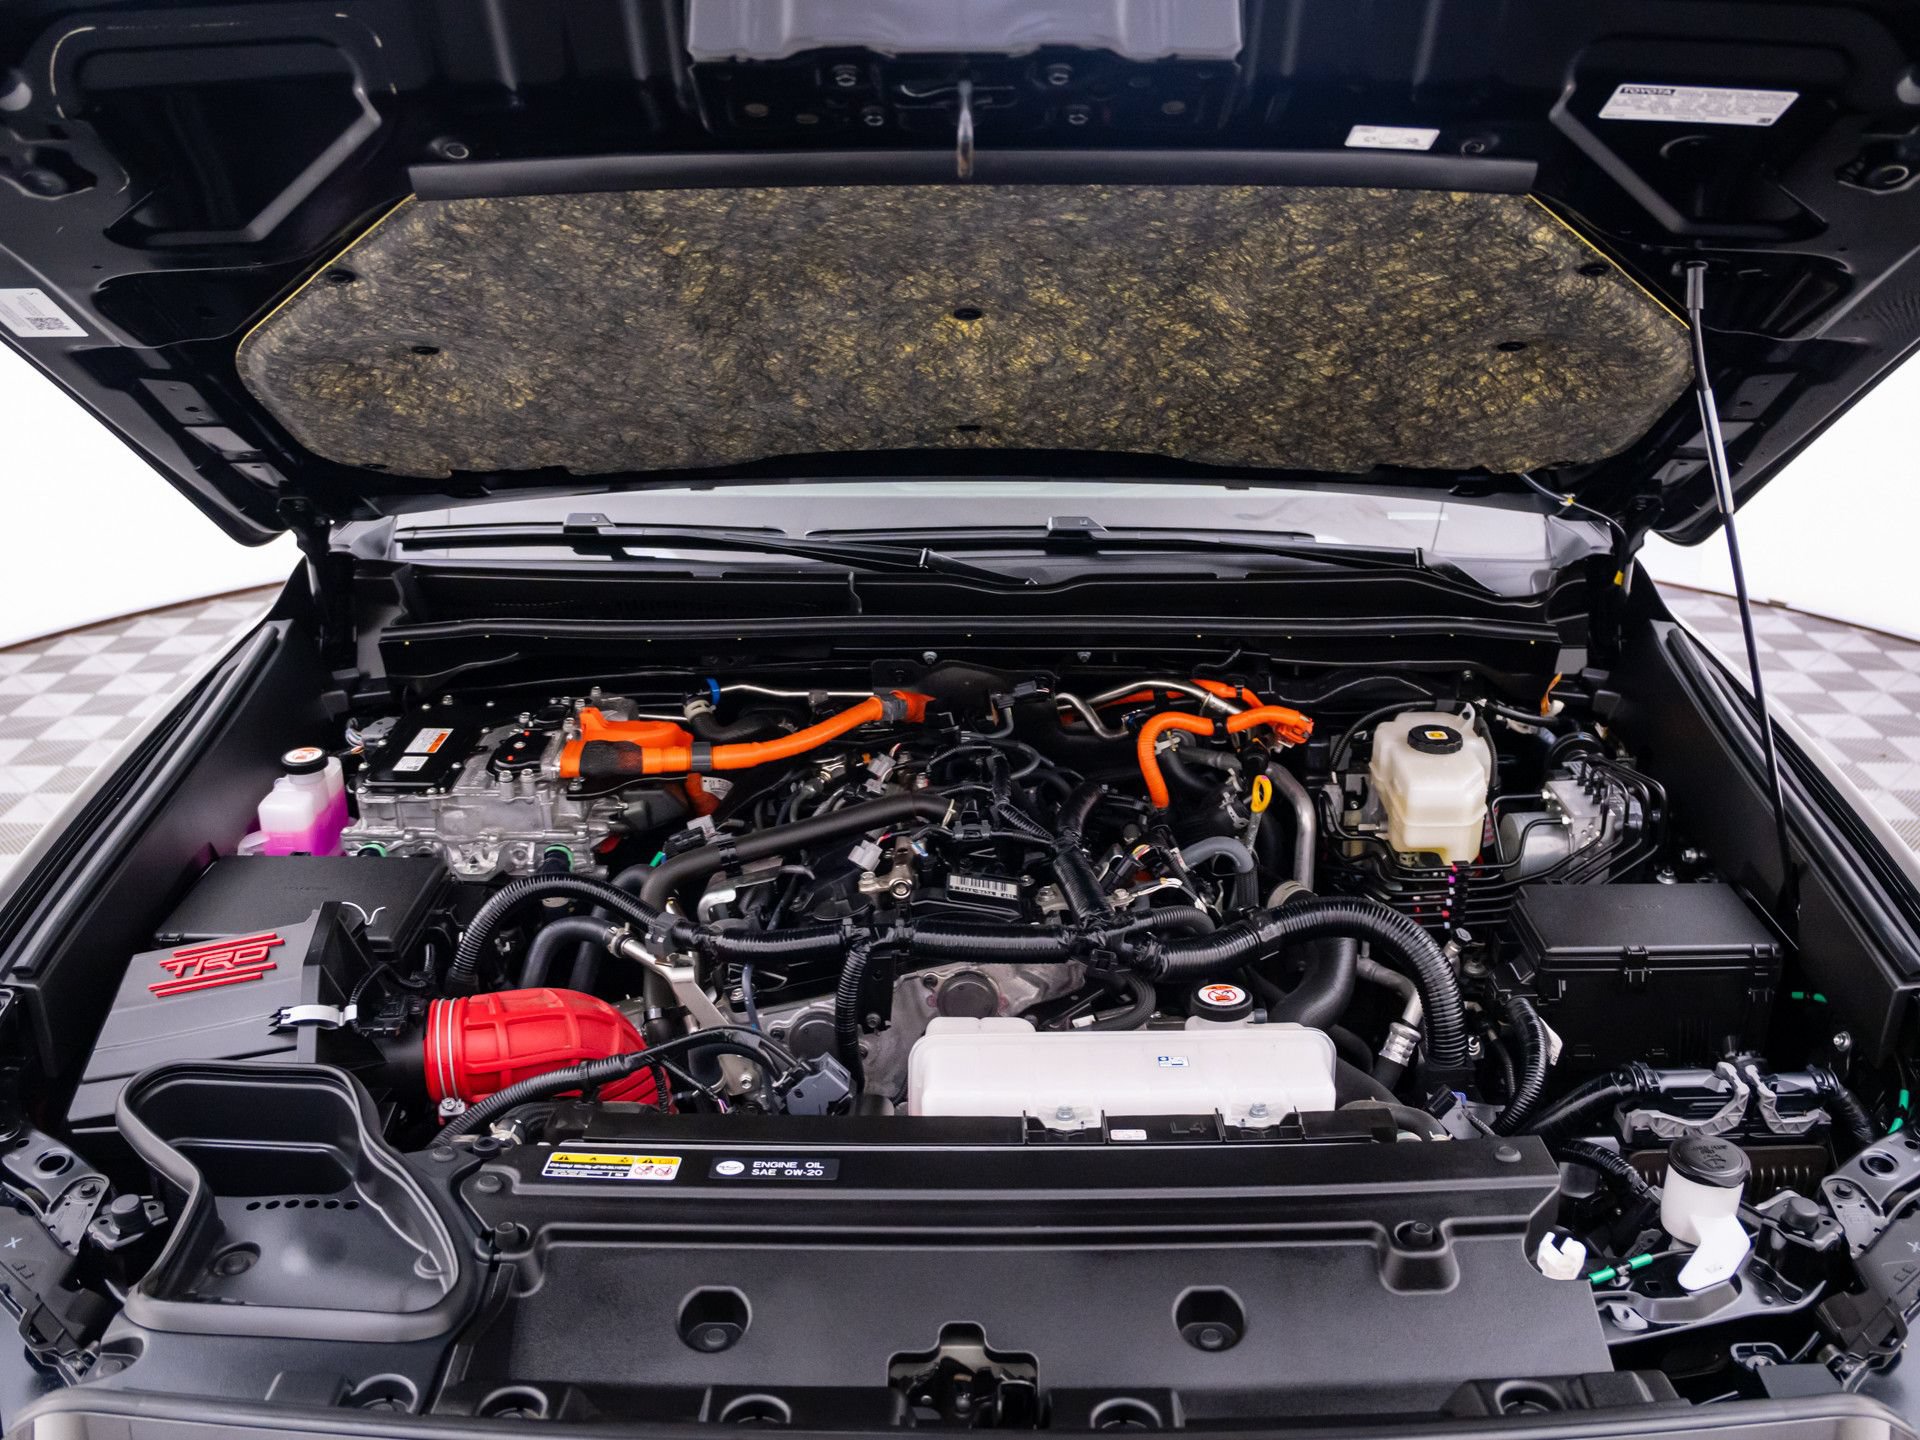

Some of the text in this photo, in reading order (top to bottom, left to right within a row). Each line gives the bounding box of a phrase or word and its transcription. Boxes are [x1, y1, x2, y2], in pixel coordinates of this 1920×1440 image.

[165, 945, 271, 978] TRD
[752, 1161, 798, 1169] ENGINE
[784, 1169, 824, 1177] 0W-20
